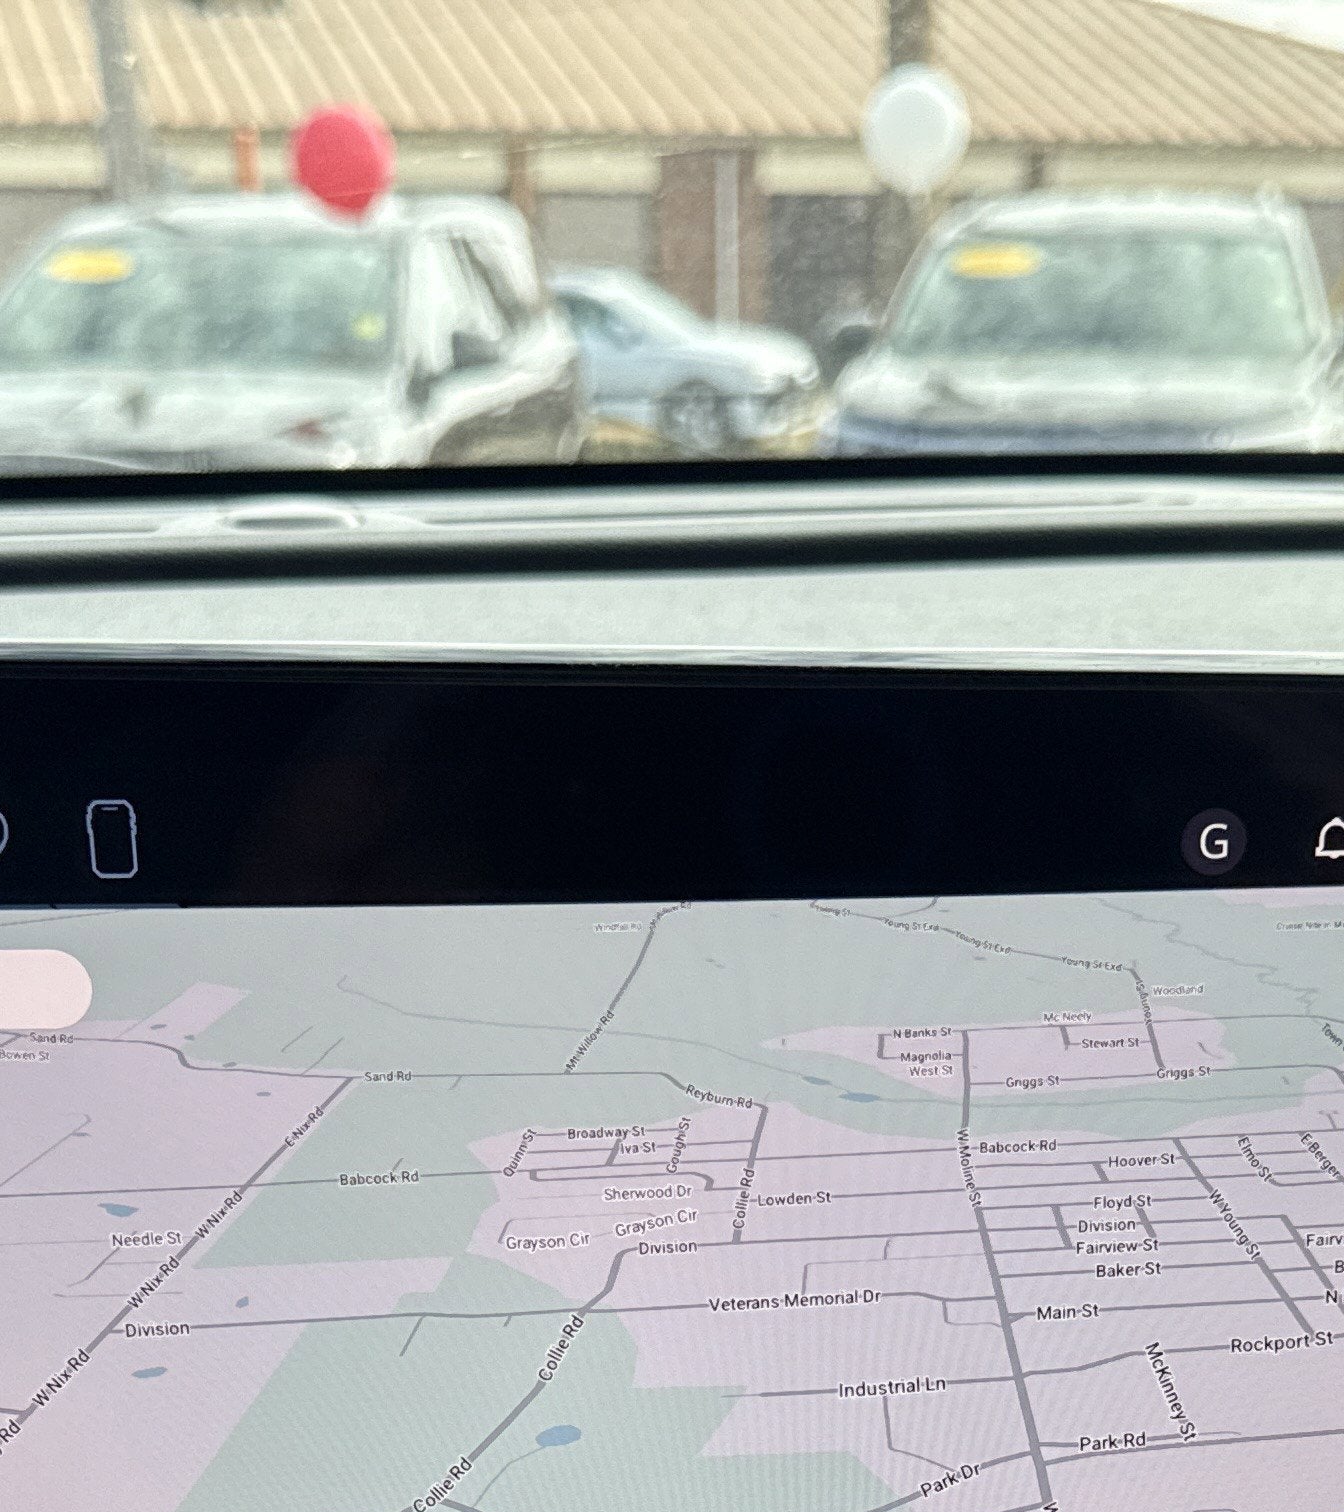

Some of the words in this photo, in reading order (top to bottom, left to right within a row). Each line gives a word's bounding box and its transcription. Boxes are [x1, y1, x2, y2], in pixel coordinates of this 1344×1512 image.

[1199, 824, 1229, 860] G
[1154, 984, 1204, 996] Woodland
[30, 1033, 57, 1044] Sand
[60, 1033, 74, 1044] Rd
[894, 1029, 901, 1038] N
[904, 1029, 937, 1038] Banks
[940, 1028, 952, 1036] St
[901, 1052, 951, 1062] Magnolia
[568, 1129, 629, 1139] Broadway
[632, 1128, 645, 1136] St
[979, 1140, 1030, 1154] Babcock
[1033, 1138, 1057, 1152] Rd
[1108, 1154, 1155, 1168] Hoover
[1158, 1153, 1175, 1166] St
[340, 1173, 399, 1186] Babcock
[402, 1170, 419, 1183] Rd
[740, 1168, 755, 1187] Rd
[604, 1188, 674, 1200] Sherwood
[677, 1185, 692, 1197] Dr
[758, 1192, 810, 1206] Lowden
[814, 1190, 831, 1203] St
[1094, 1195, 1130, 1209] Floyd
[1135, 1194, 1152, 1207] St
[195, 1222, 213, 1239] W
[206, 1206, 228, 1227] Nix
[223, 1191, 243, 1212] Rd
[732, 1191, 751, 1229] Collie
[1078, 1218, 1136, 1232] Division
[112, 1232, 161, 1246] Needle
[165, 1231, 181, 1245] St
[506, 1236, 565, 1250] Grayson
[570, 1233, 590, 1245] Cir
[1076, 1241, 1137, 1254] Fairview
[1141, 1239, 1158, 1252] St
[639, 1241, 698, 1254] Division
[1096, 1264, 1139, 1277] Baker
[1144, 1262, 1162, 1275] St
[127, 1289, 148, 1309] W
[143, 1271, 167, 1294] Nix
[159, 1256, 180, 1279] Rd
[709, 1293, 780, 1311] Veterans
[785, 1290, 858, 1307] Memorial
[864, 1289, 882, 1304] Dr
[1326, 1291, 1337, 1303] N
[1037, 1305, 1077, 1319] Main
[1082, 1304, 1099, 1317] St
[125, 1321, 190, 1337] Division
[539, 1336, 572, 1382] Collie
[563, 1315, 584, 1338] Rd
[1230, 1334, 1310, 1354] Rockport
[1314, 1331, 1334, 1347] St
[34, 1386, 53, 1407] W
[47, 1369, 72, 1392] Nix
[68, 1348, 90, 1372] Rd
[839, 1379, 919, 1397] Industrial
[925, 1376, 946, 1391] Ln
[1145, 1341, 1185, 1424] McKinney
[1178, 1421, 1197, 1441] St
[1080, 1435, 1117, 1450] Park
[1124, 1432, 1145, 1447] Rd
[414, 1476, 458, 1512] Collie
[450, 1457, 473, 1482] Rd
[920, 1472, 958, 1498] Park
[955, 1462, 977, 1479] Dr
